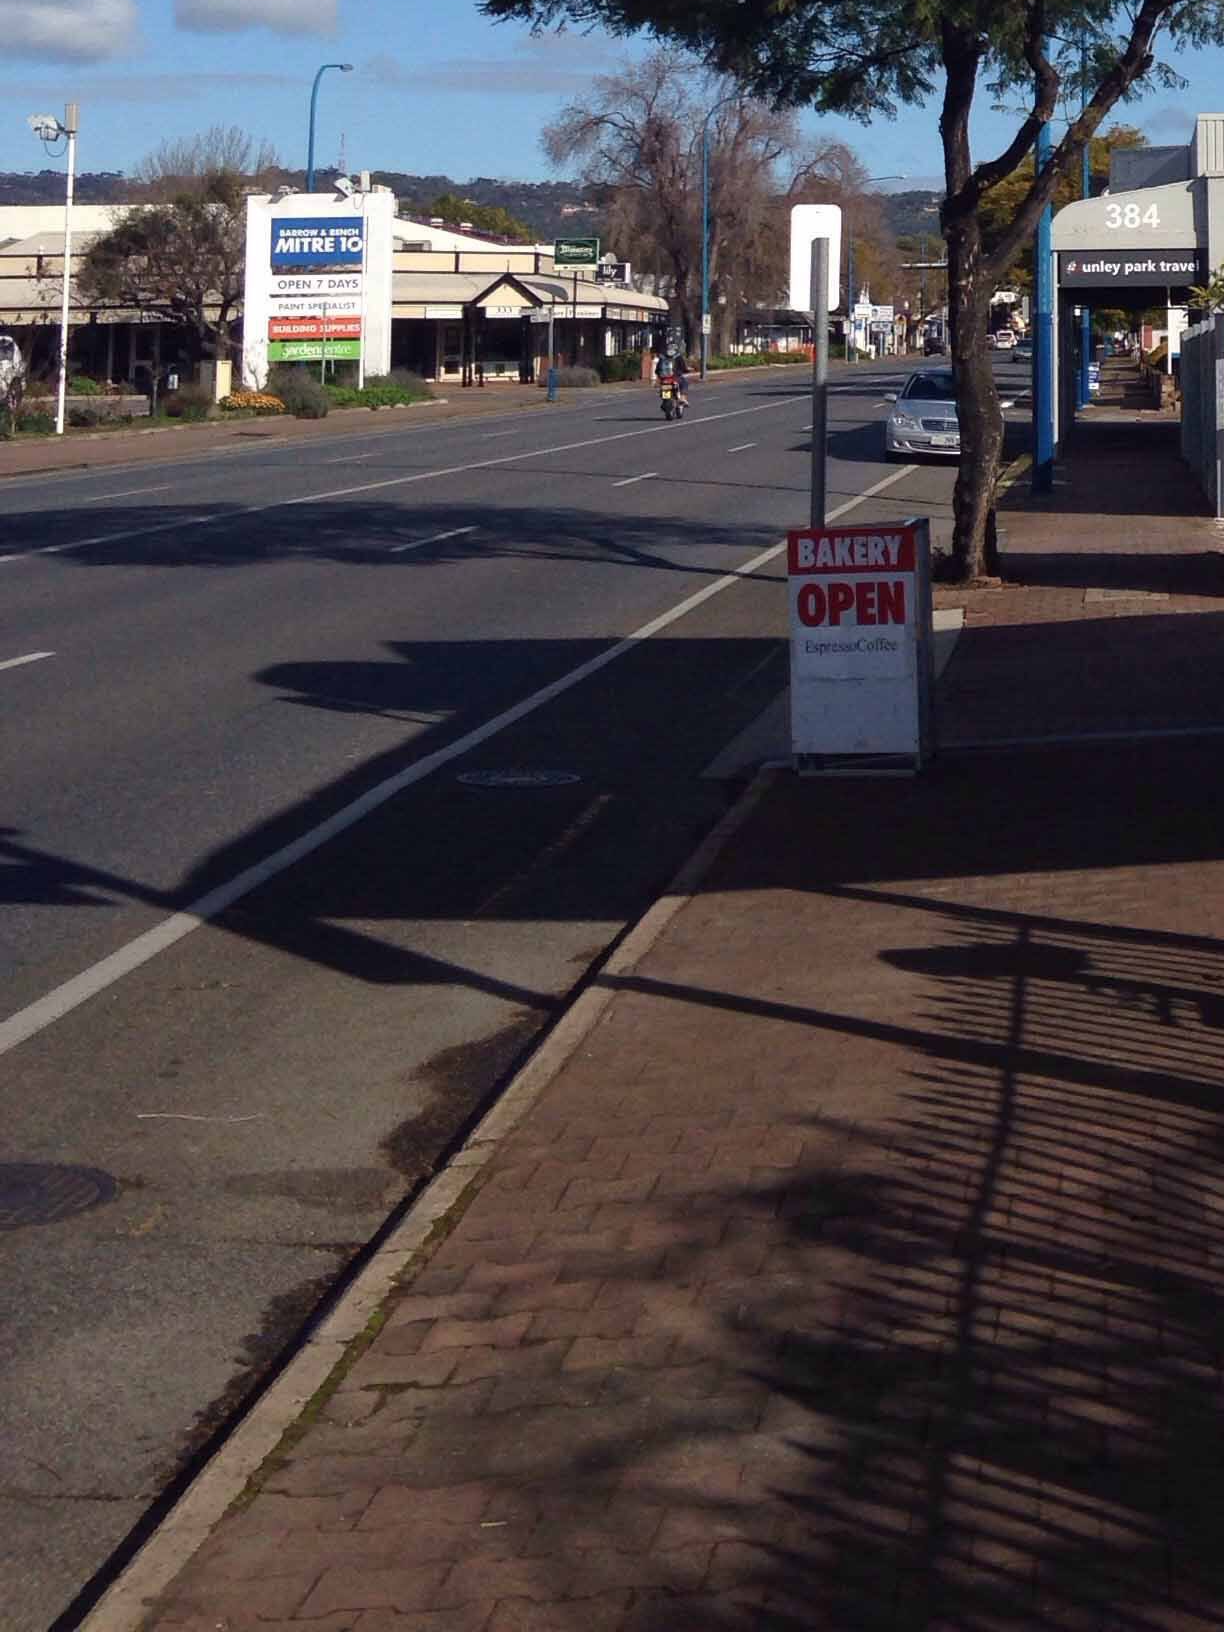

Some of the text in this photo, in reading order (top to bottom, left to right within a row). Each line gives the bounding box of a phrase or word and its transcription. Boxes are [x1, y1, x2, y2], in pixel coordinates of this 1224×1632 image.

[1105, 203, 1160, 228] 384
[275, 237, 363, 253] MITRE 10
[1082, 259, 1200, 276] unley park travel
[278, 278, 359, 289] OPEN 7 DAYS
[796, 535, 902, 568] BAKERY
[796, 580, 906, 627] OPEN
